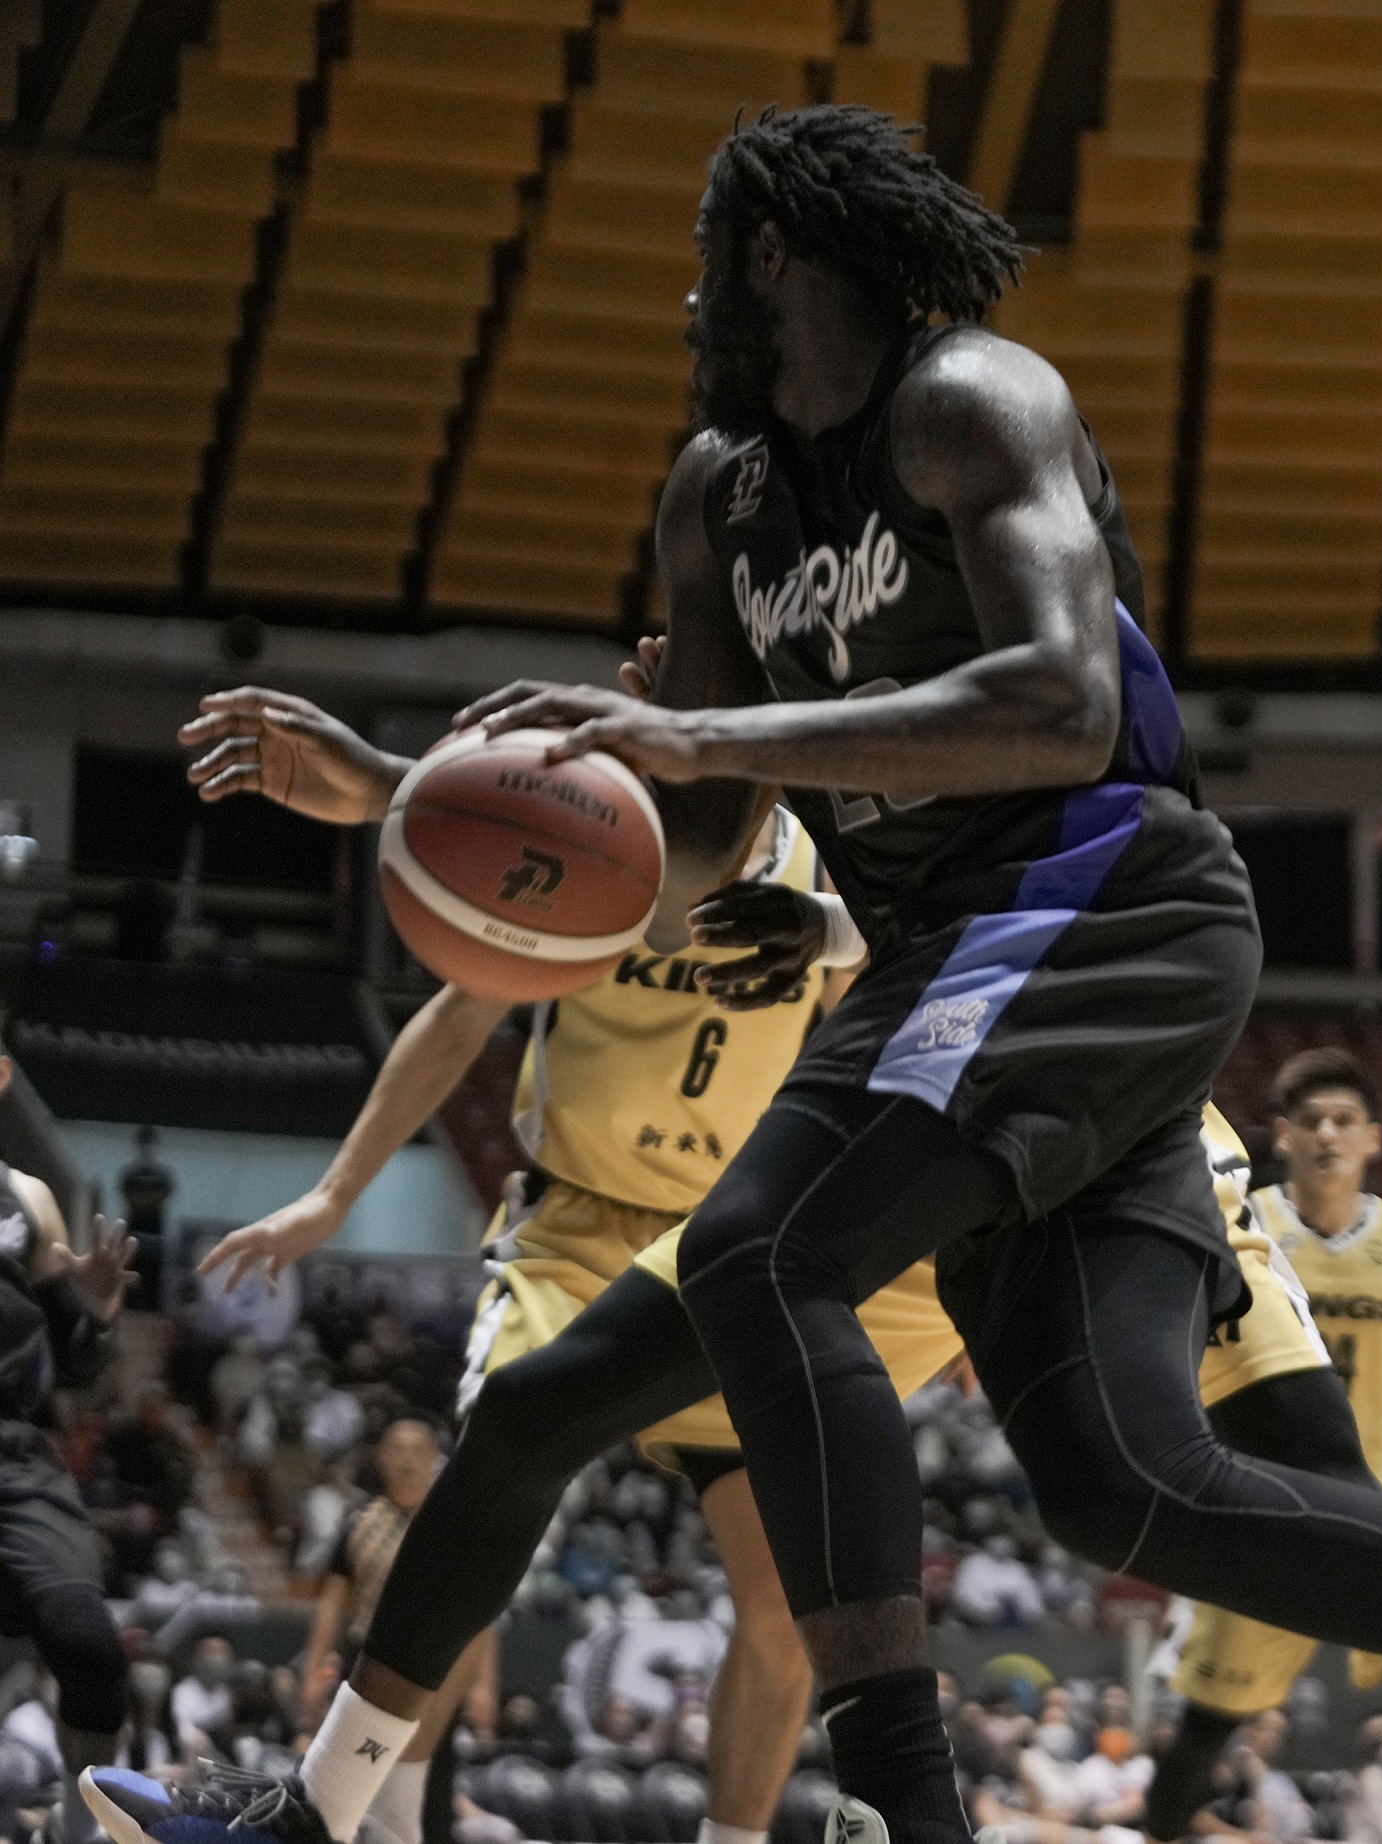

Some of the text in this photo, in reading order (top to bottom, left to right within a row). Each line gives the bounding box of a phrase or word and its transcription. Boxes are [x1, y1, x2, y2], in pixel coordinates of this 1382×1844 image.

[497, 767, 619, 828] molten
[616, 953, 808, 1003] KIN
[681, 1016, 728, 1098] 6
